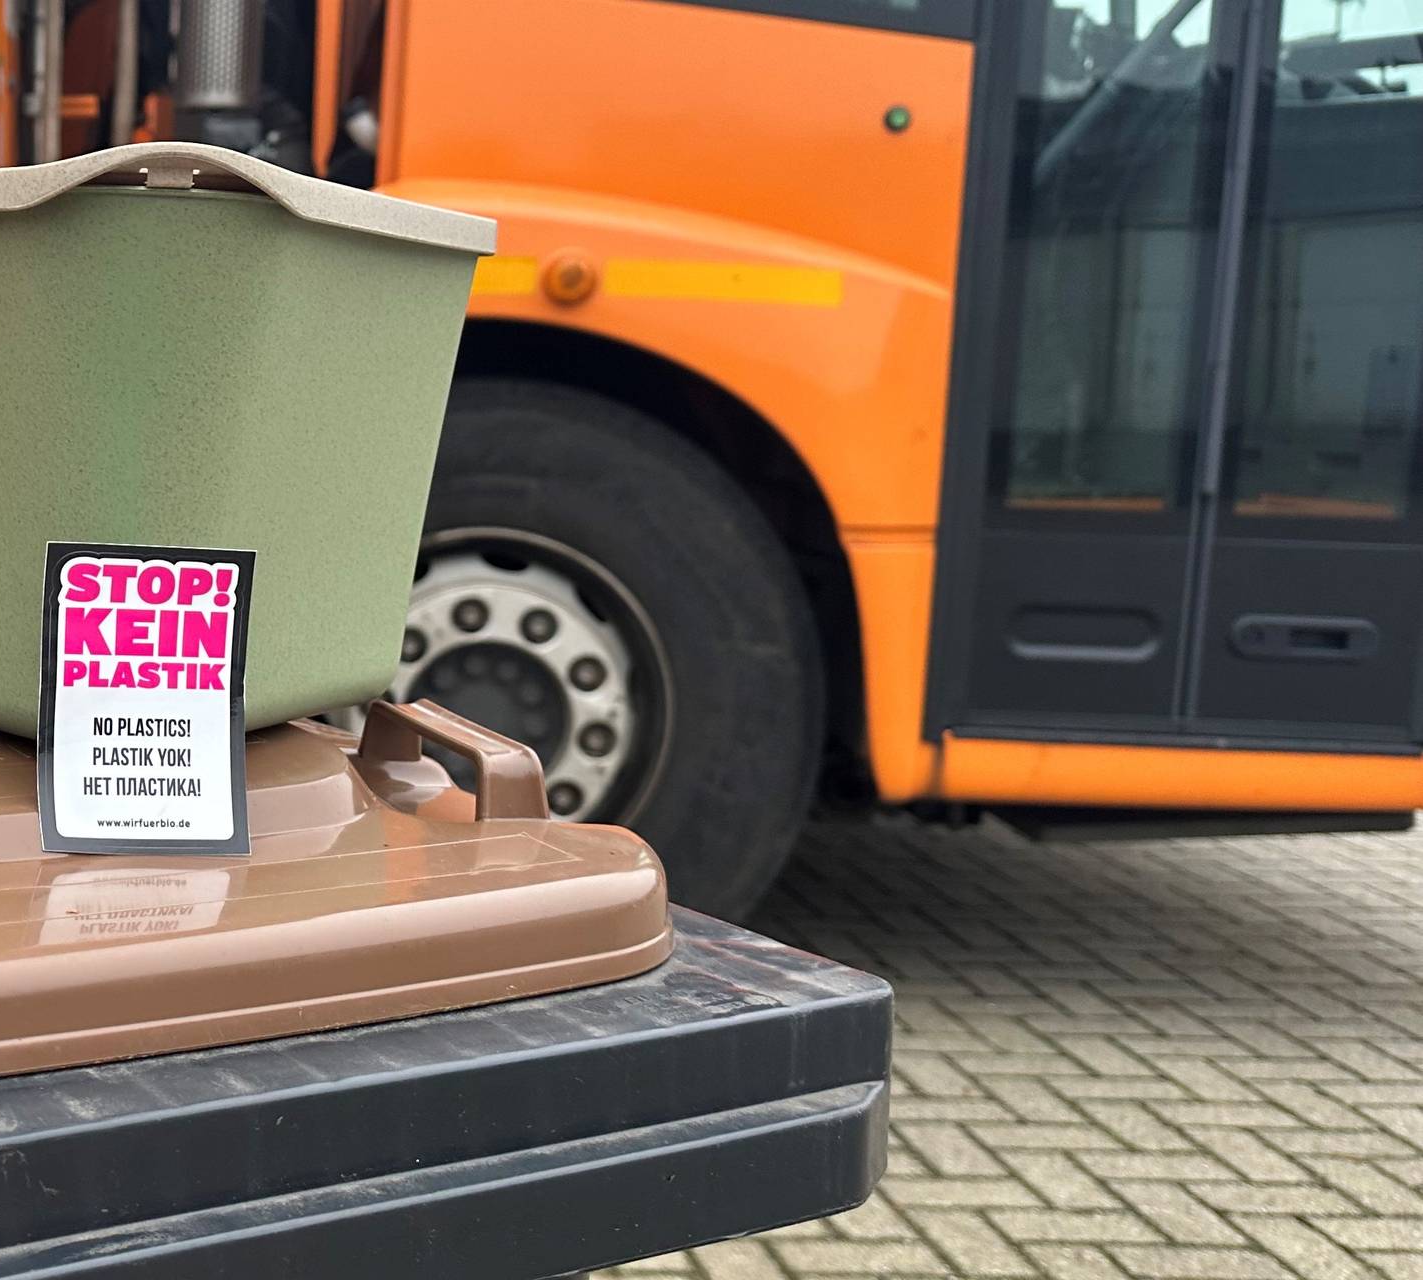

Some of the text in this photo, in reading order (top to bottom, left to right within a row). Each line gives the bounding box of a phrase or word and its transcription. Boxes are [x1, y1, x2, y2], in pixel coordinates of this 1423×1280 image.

[65, 563, 234, 608] STOP!
[64, 607, 228, 659] KEIN
[63, 660, 226, 691] PLASTIK
[93, 717, 191, 737] NO PLASTICS!
[93, 747, 191, 767] PLASTIK YOK!
[83, 777, 201, 797] НЕТ ПЛАСТИКА!
[97, 818, 191, 828] www.wirfuerbio.de
